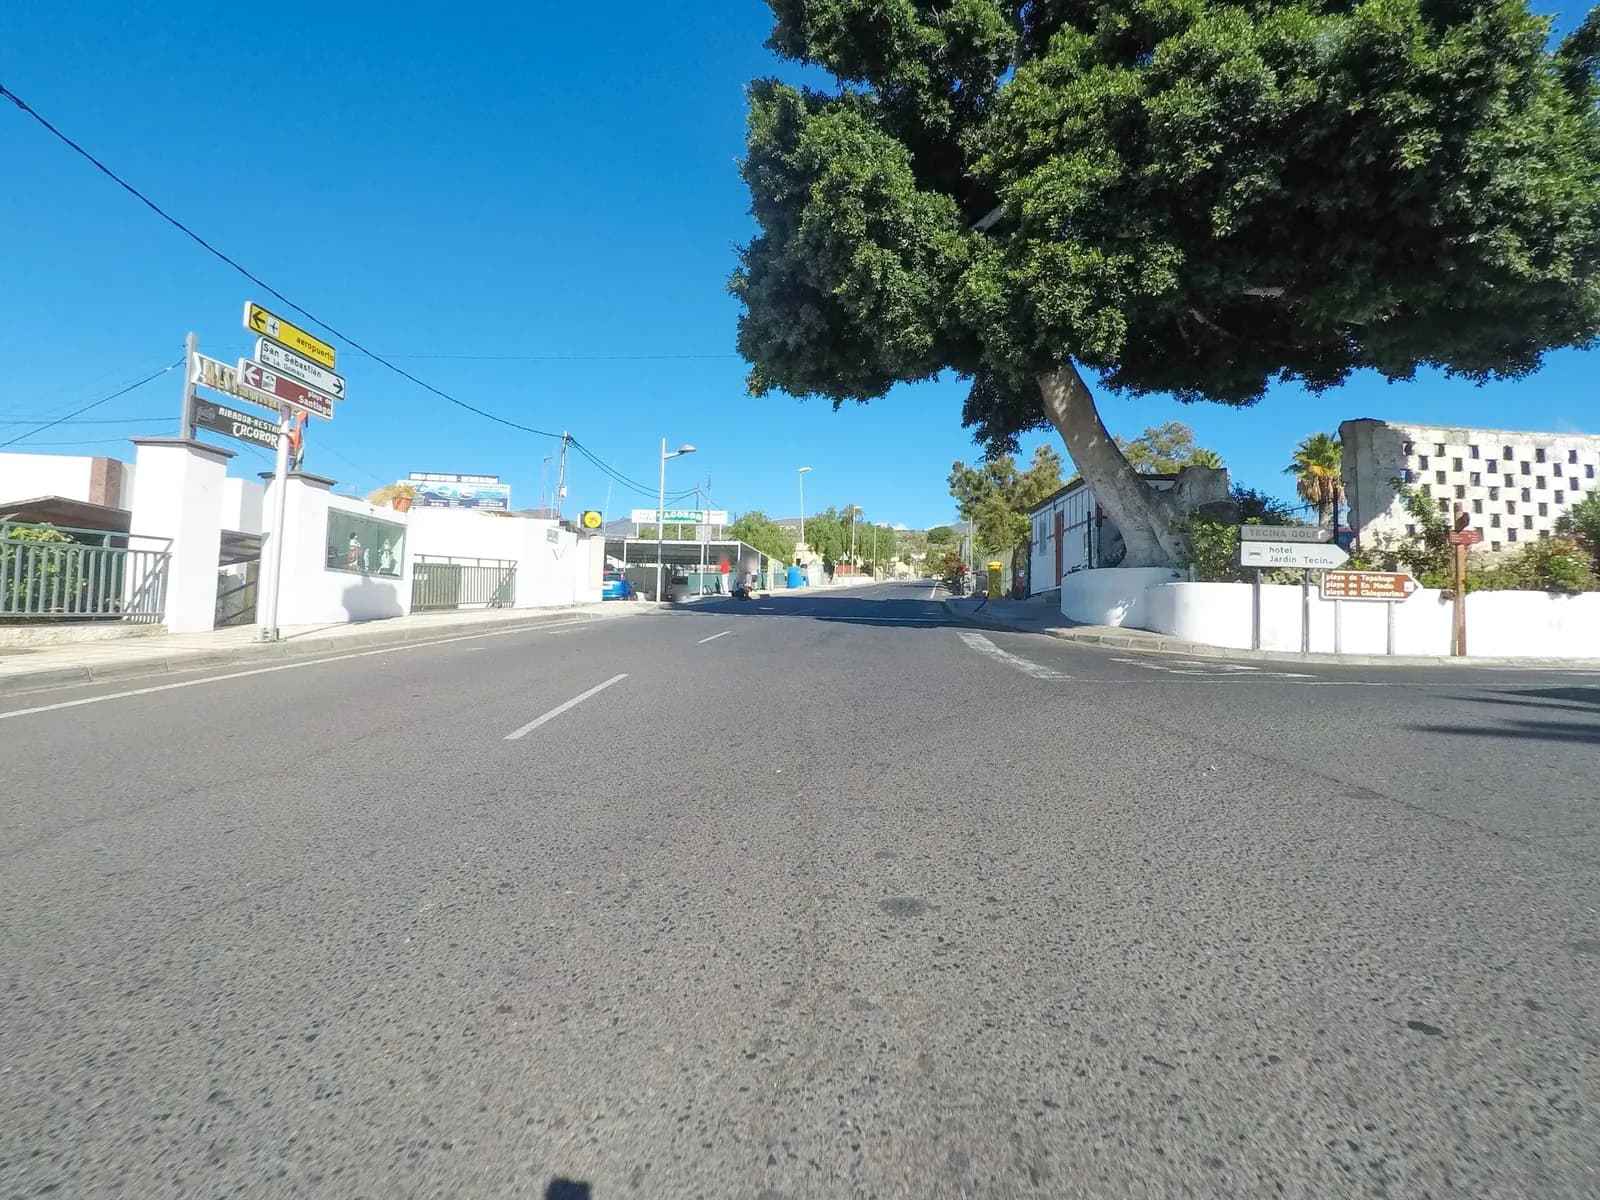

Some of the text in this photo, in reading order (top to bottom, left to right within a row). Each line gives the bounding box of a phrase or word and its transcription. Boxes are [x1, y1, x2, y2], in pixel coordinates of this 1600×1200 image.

[263, 343, 280, 357] San
[296, 337, 334, 361] aeropuerto
[283, 363, 305, 379] Gomera
[298, 395, 331, 415] Santiago
[1249, 529, 1318, 538] TECINA GOLF
[1269, 546, 1293, 554] hotel
